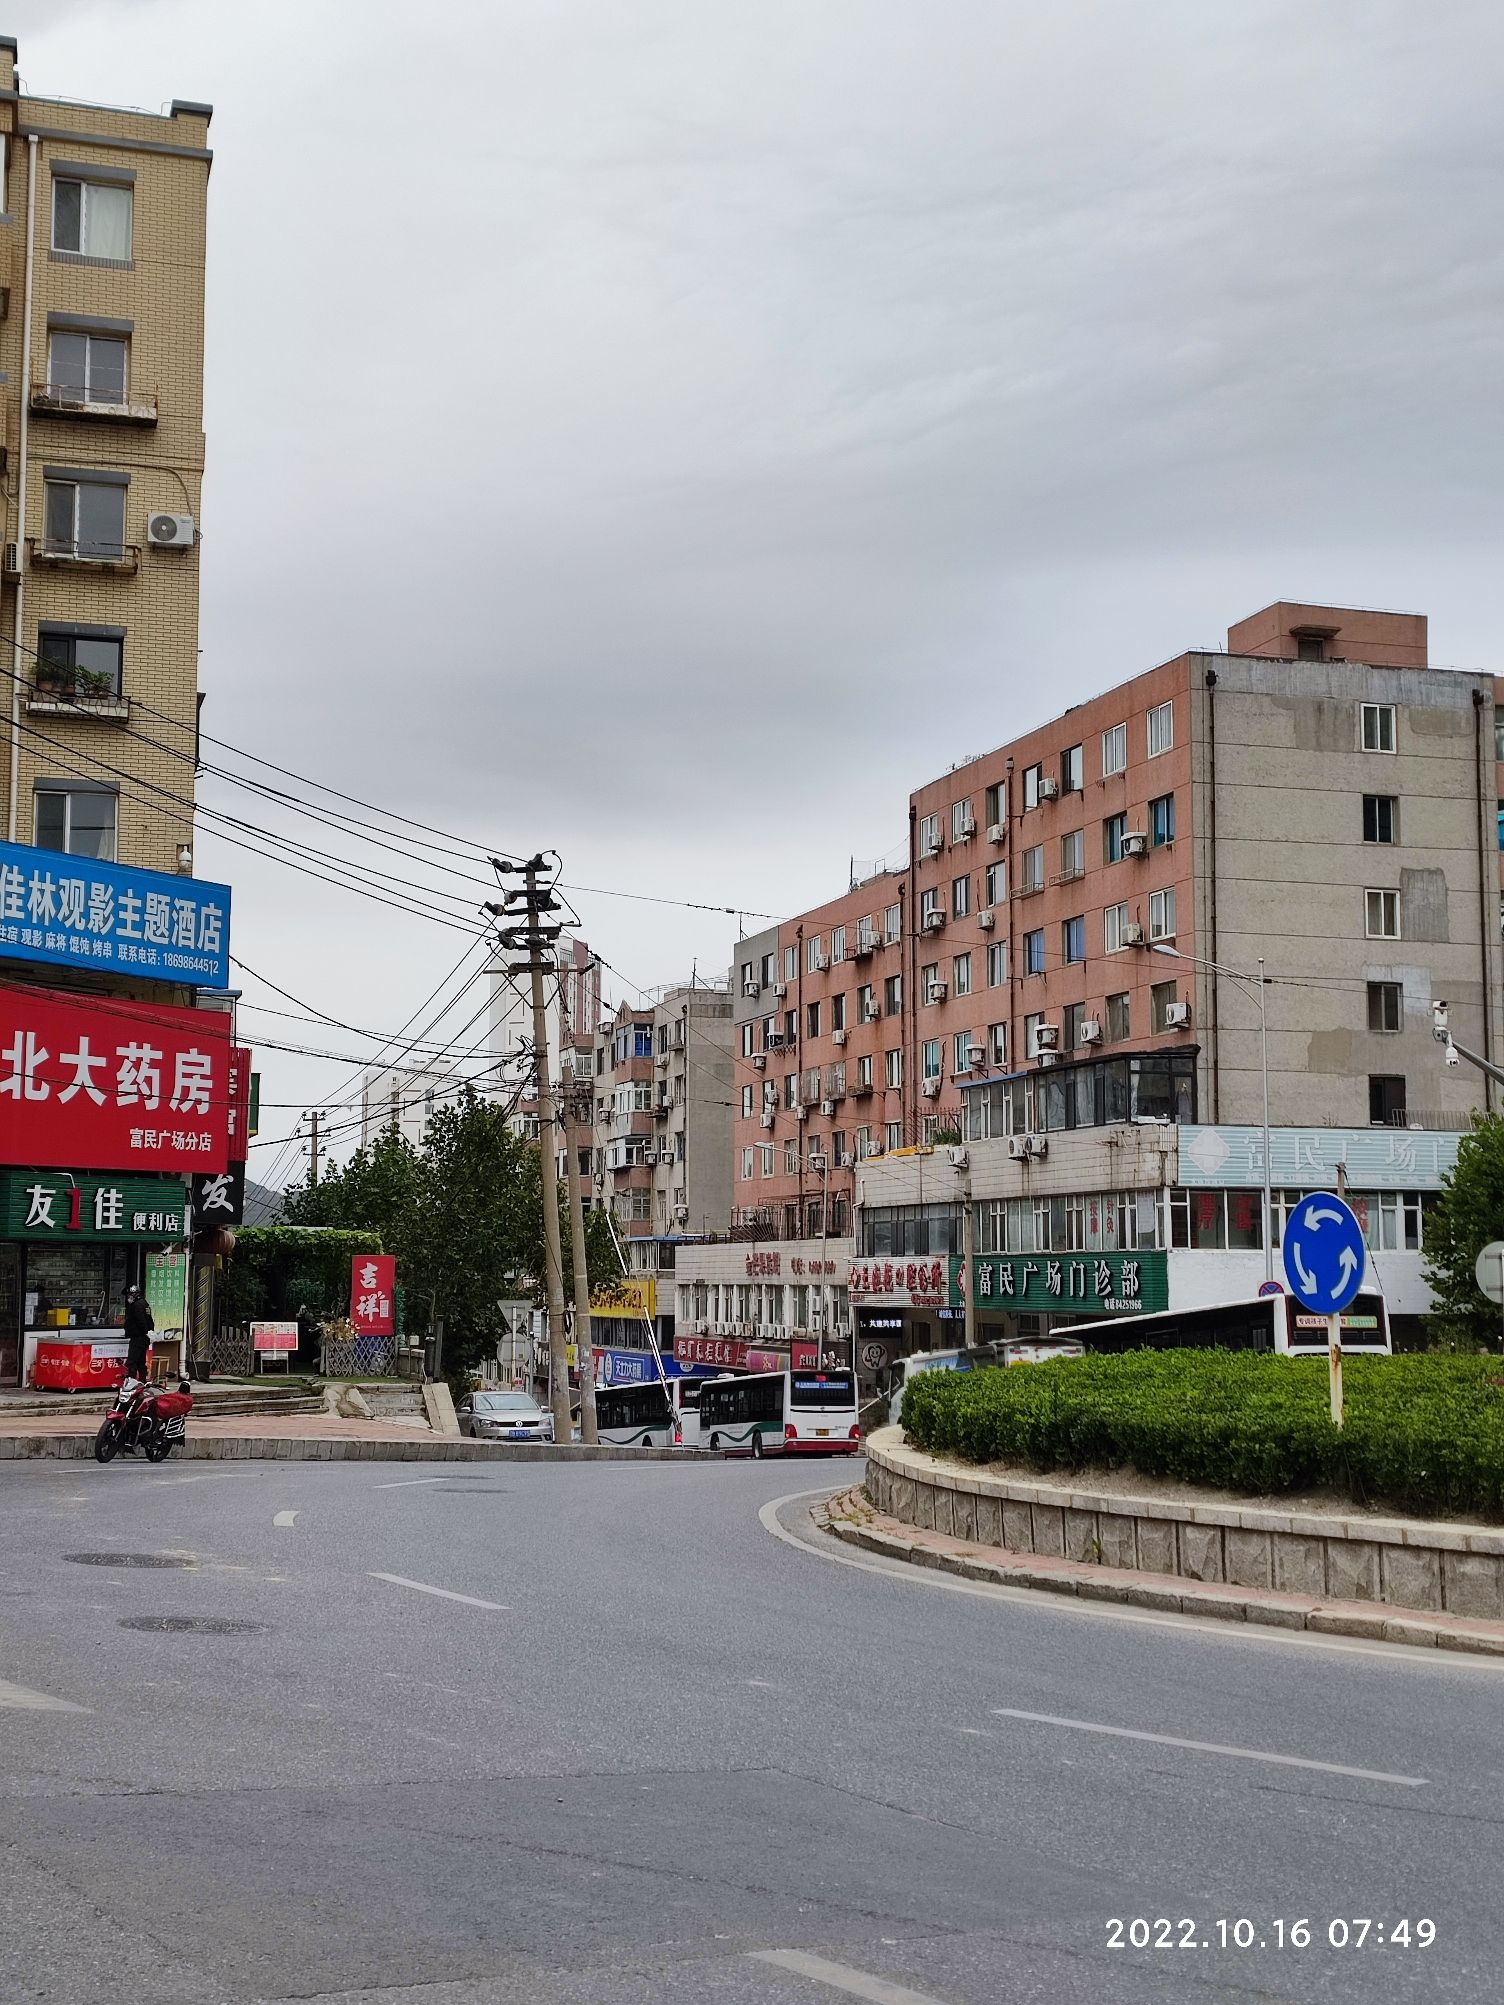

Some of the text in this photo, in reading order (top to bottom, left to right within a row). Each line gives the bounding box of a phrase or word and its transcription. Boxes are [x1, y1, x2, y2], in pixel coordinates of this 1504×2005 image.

[0, 863, 223, 954] 佳林观影主题酒店
[20, 928, 42, 947] 观影
[45, 932, 67, 951] 麻将
[68, 935, 90, 955] 馄饨
[92, 939, 113, 959] 烤串
[162, 952, 219, 976] 18698644512
[1, 1030, 213, 1115] 北大药房
[130, 1127, 212, 1152] 富民广场分店
[133, 1211, 179, 1232] 便利店
[356, 1262, 385, 1323] 吉祥
[978, 1259, 1139, 1298] 富民广场门诊部
